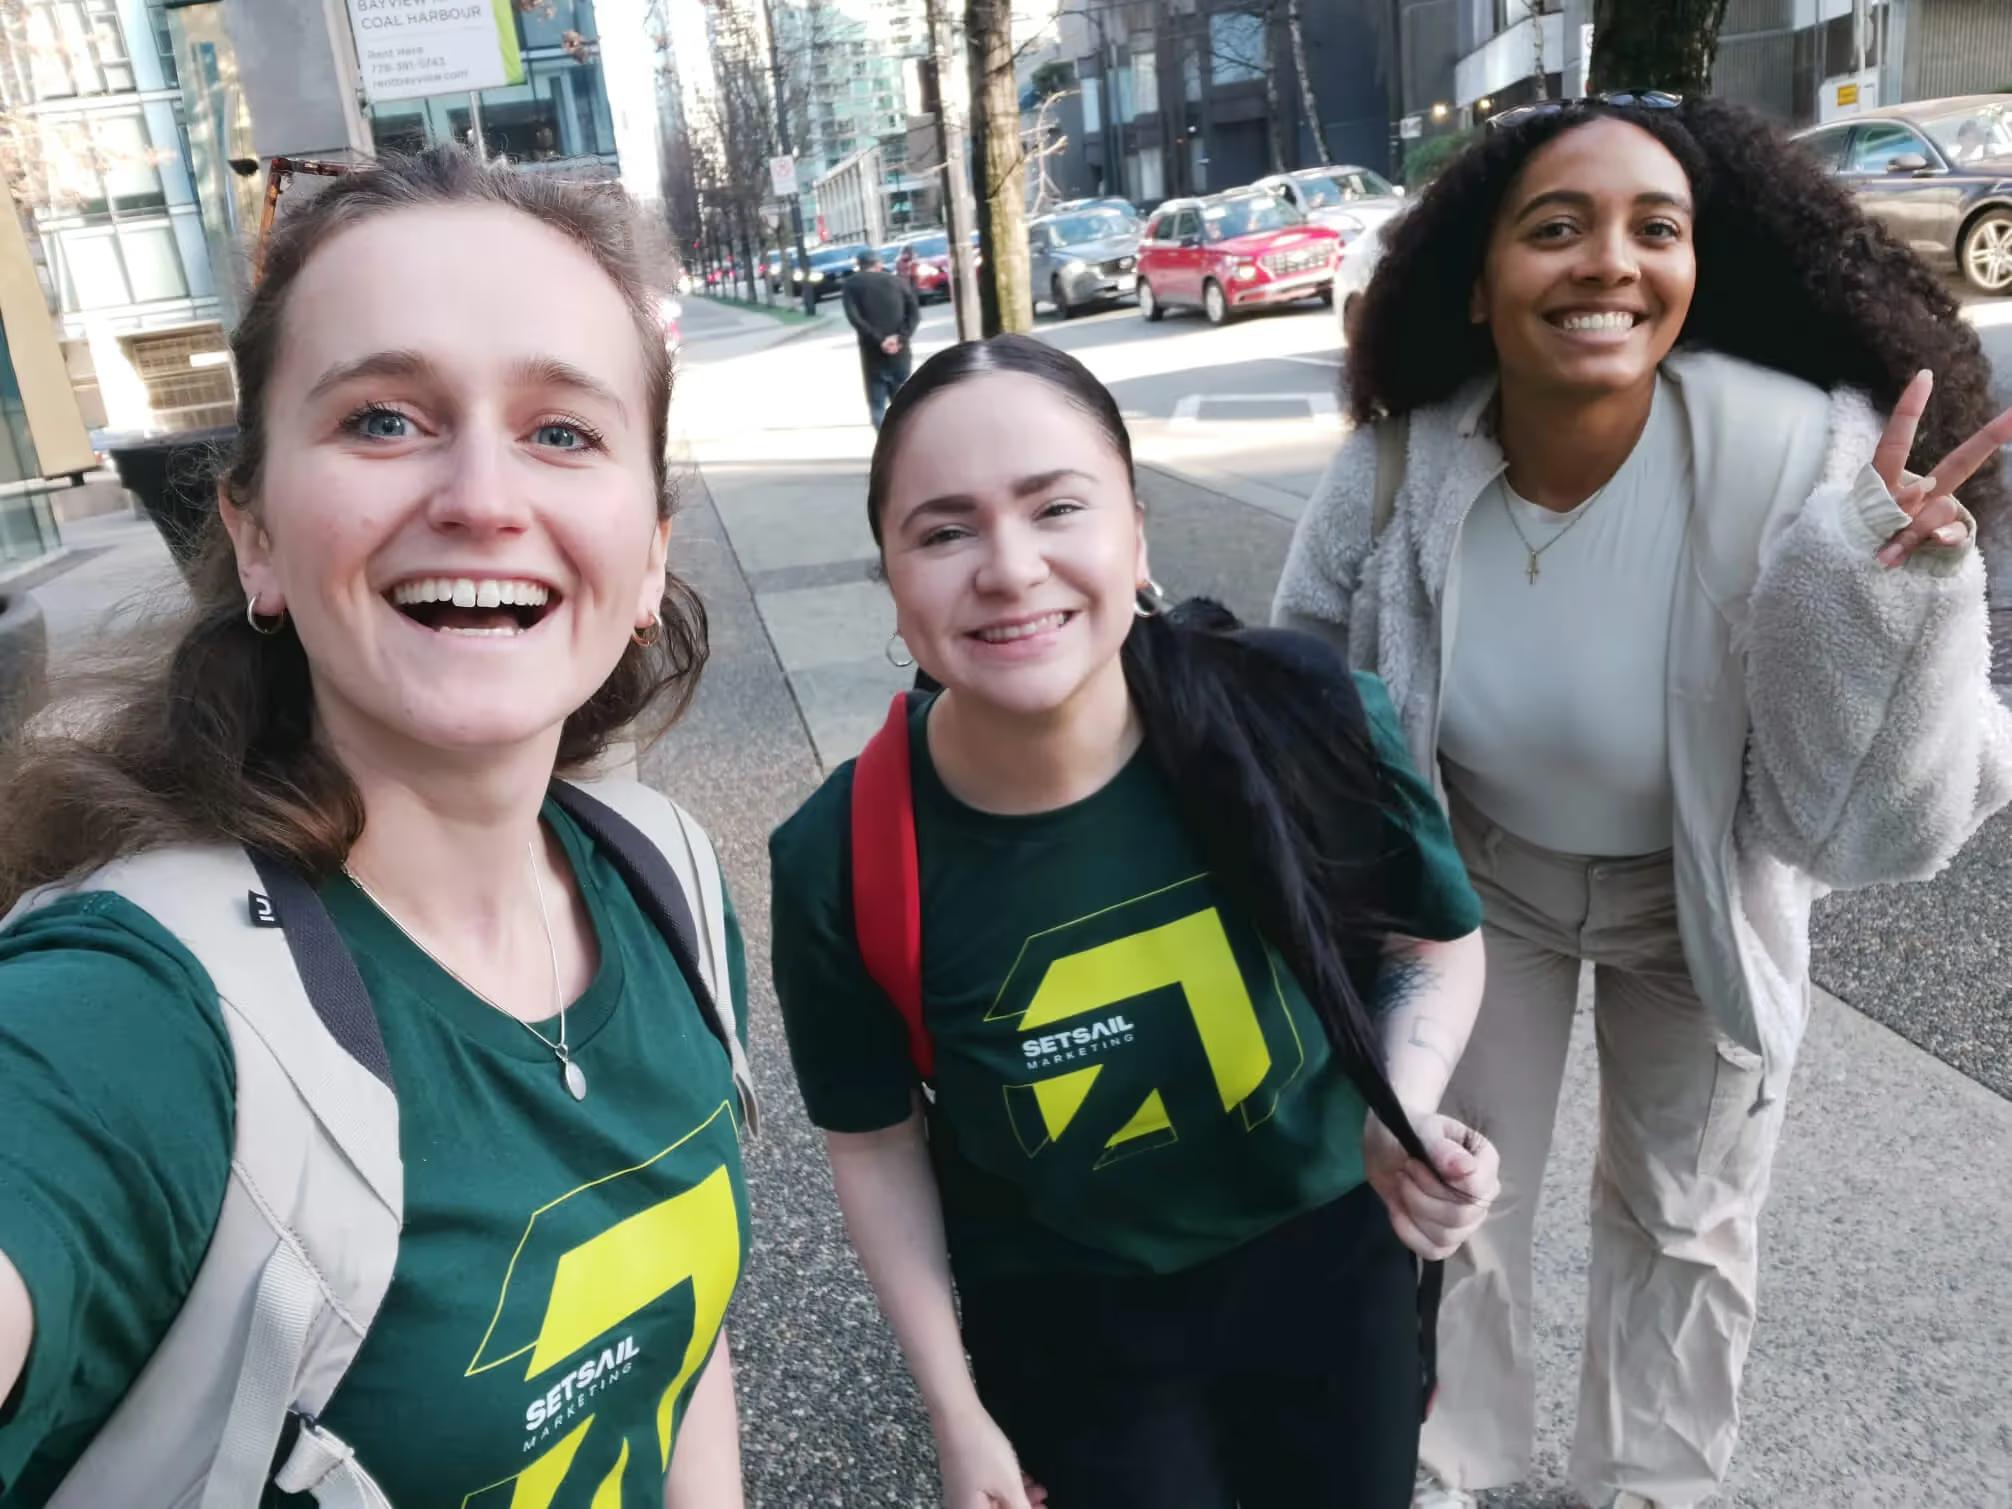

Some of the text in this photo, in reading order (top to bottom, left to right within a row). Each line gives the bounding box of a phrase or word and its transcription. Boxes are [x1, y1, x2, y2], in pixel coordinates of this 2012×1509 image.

[361, 6, 481, 29] COAL HARBOUR
[1022, 1015, 1135, 1057] SETSAIL
[1027, 1033, 1134, 1070] MARKETING
[526, 1335, 640, 1431] SETSAIL
[523, 1362, 632, 1452] MARKETING
